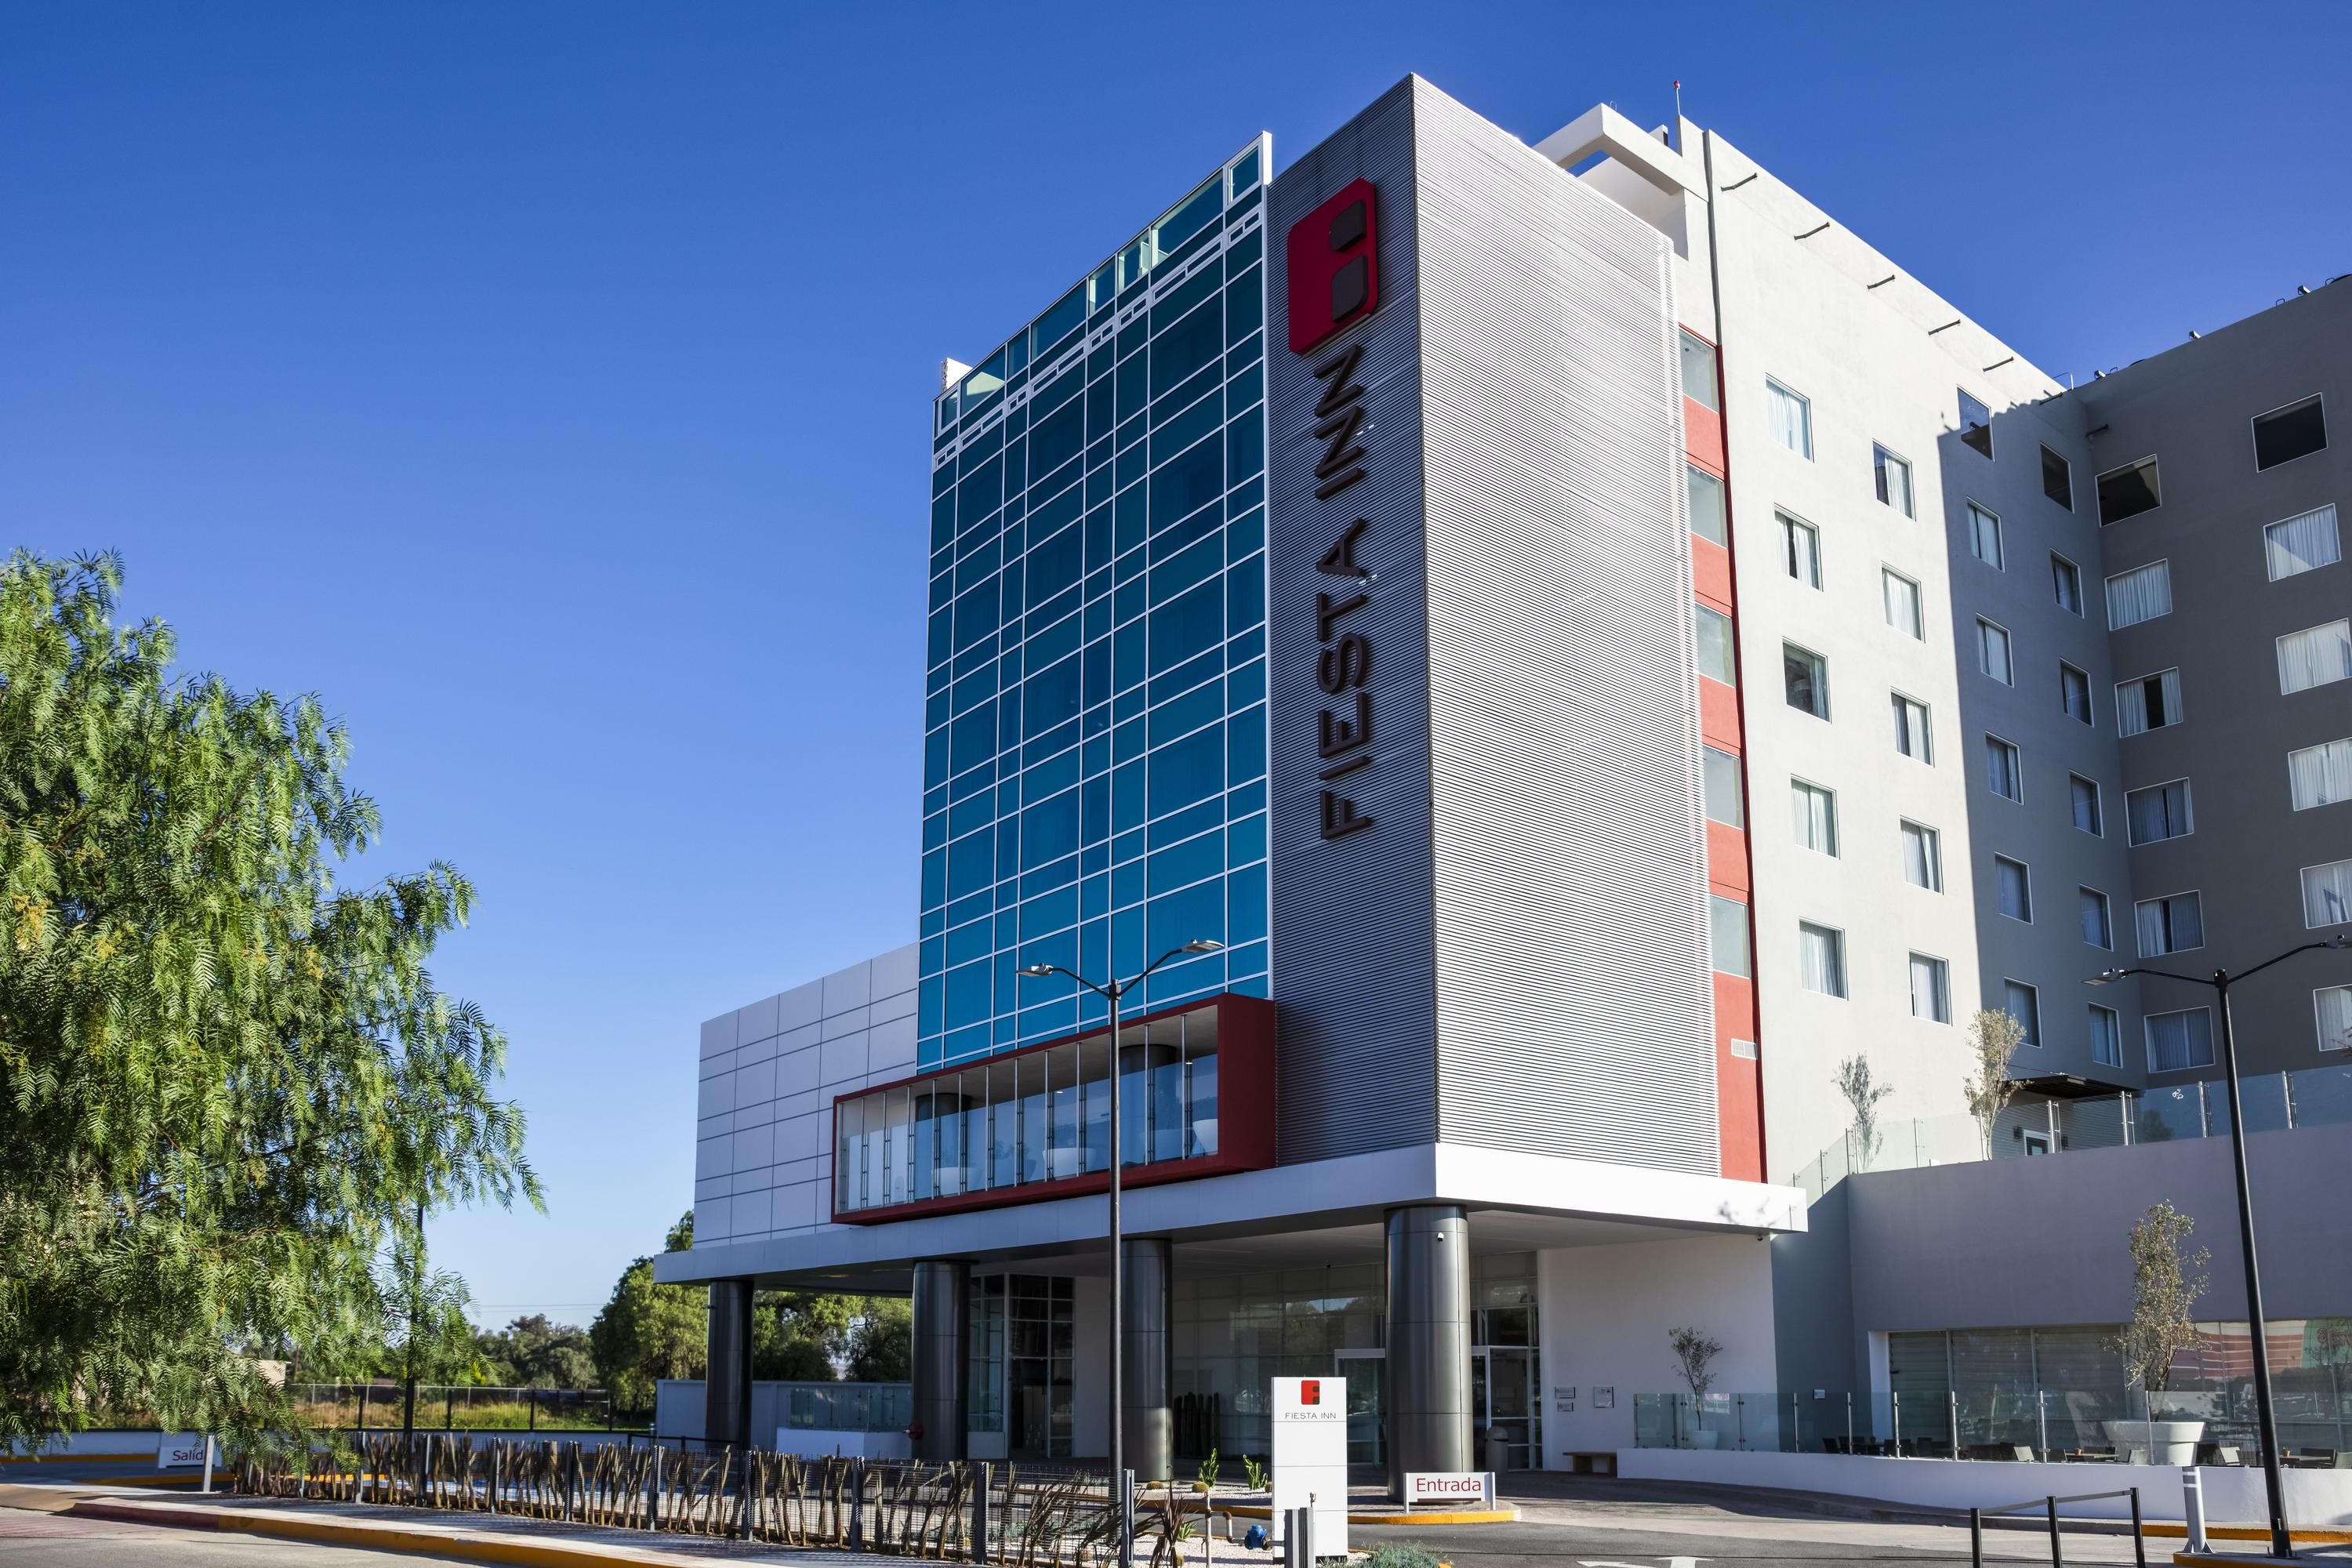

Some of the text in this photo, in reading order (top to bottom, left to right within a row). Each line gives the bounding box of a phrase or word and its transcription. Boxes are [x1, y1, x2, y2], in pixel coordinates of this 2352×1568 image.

[1314, 344, 1373, 840] FIESTA INN
[172, 1450, 206, 1461] Salid
[1417, 1477, 1481, 1492] Entrada
